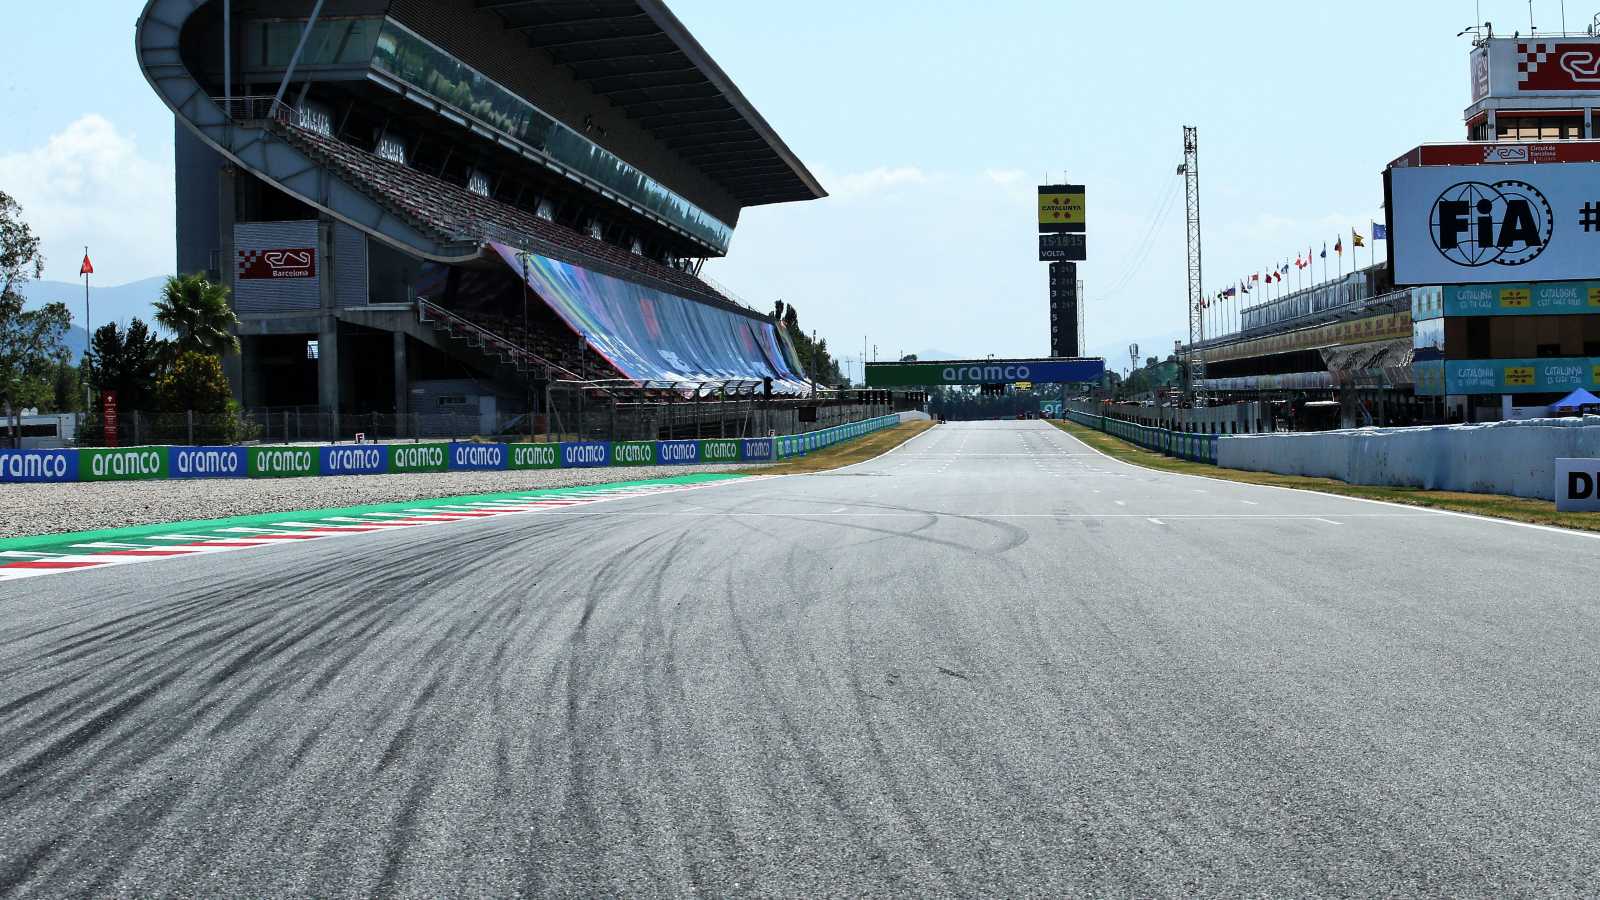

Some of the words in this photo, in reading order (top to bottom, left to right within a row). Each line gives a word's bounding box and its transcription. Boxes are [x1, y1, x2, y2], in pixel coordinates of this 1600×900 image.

[272, 269, 309, 277] Barcelona
[1051, 277, 1057, 285] 2
[1051, 290, 1057, 298] 3
[1052, 313, 1058, 321] 5
[1052, 325, 1058, 333] 6
[1052, 337, 1058, 346] 7
[942, 364, 1030, 382] aramco
[395, 447, 443, 467] aramco
[456, 446, 501, 466] aramco
[515, 445, 555, 465] aramco
[566, 444, 605, 463] aramco
[616, 443, 651, 462] aramco
[662, 442, 696, 461] aramco
[705, 442, 737, 459] aramco
[746, 440, 770, 457] aramco
[92, 452, 160, 475] aramco
[178, 451, 238, 473] aramco
[257, 450, 311, 472] aramco
[329, 449, 380, 469] aramco
